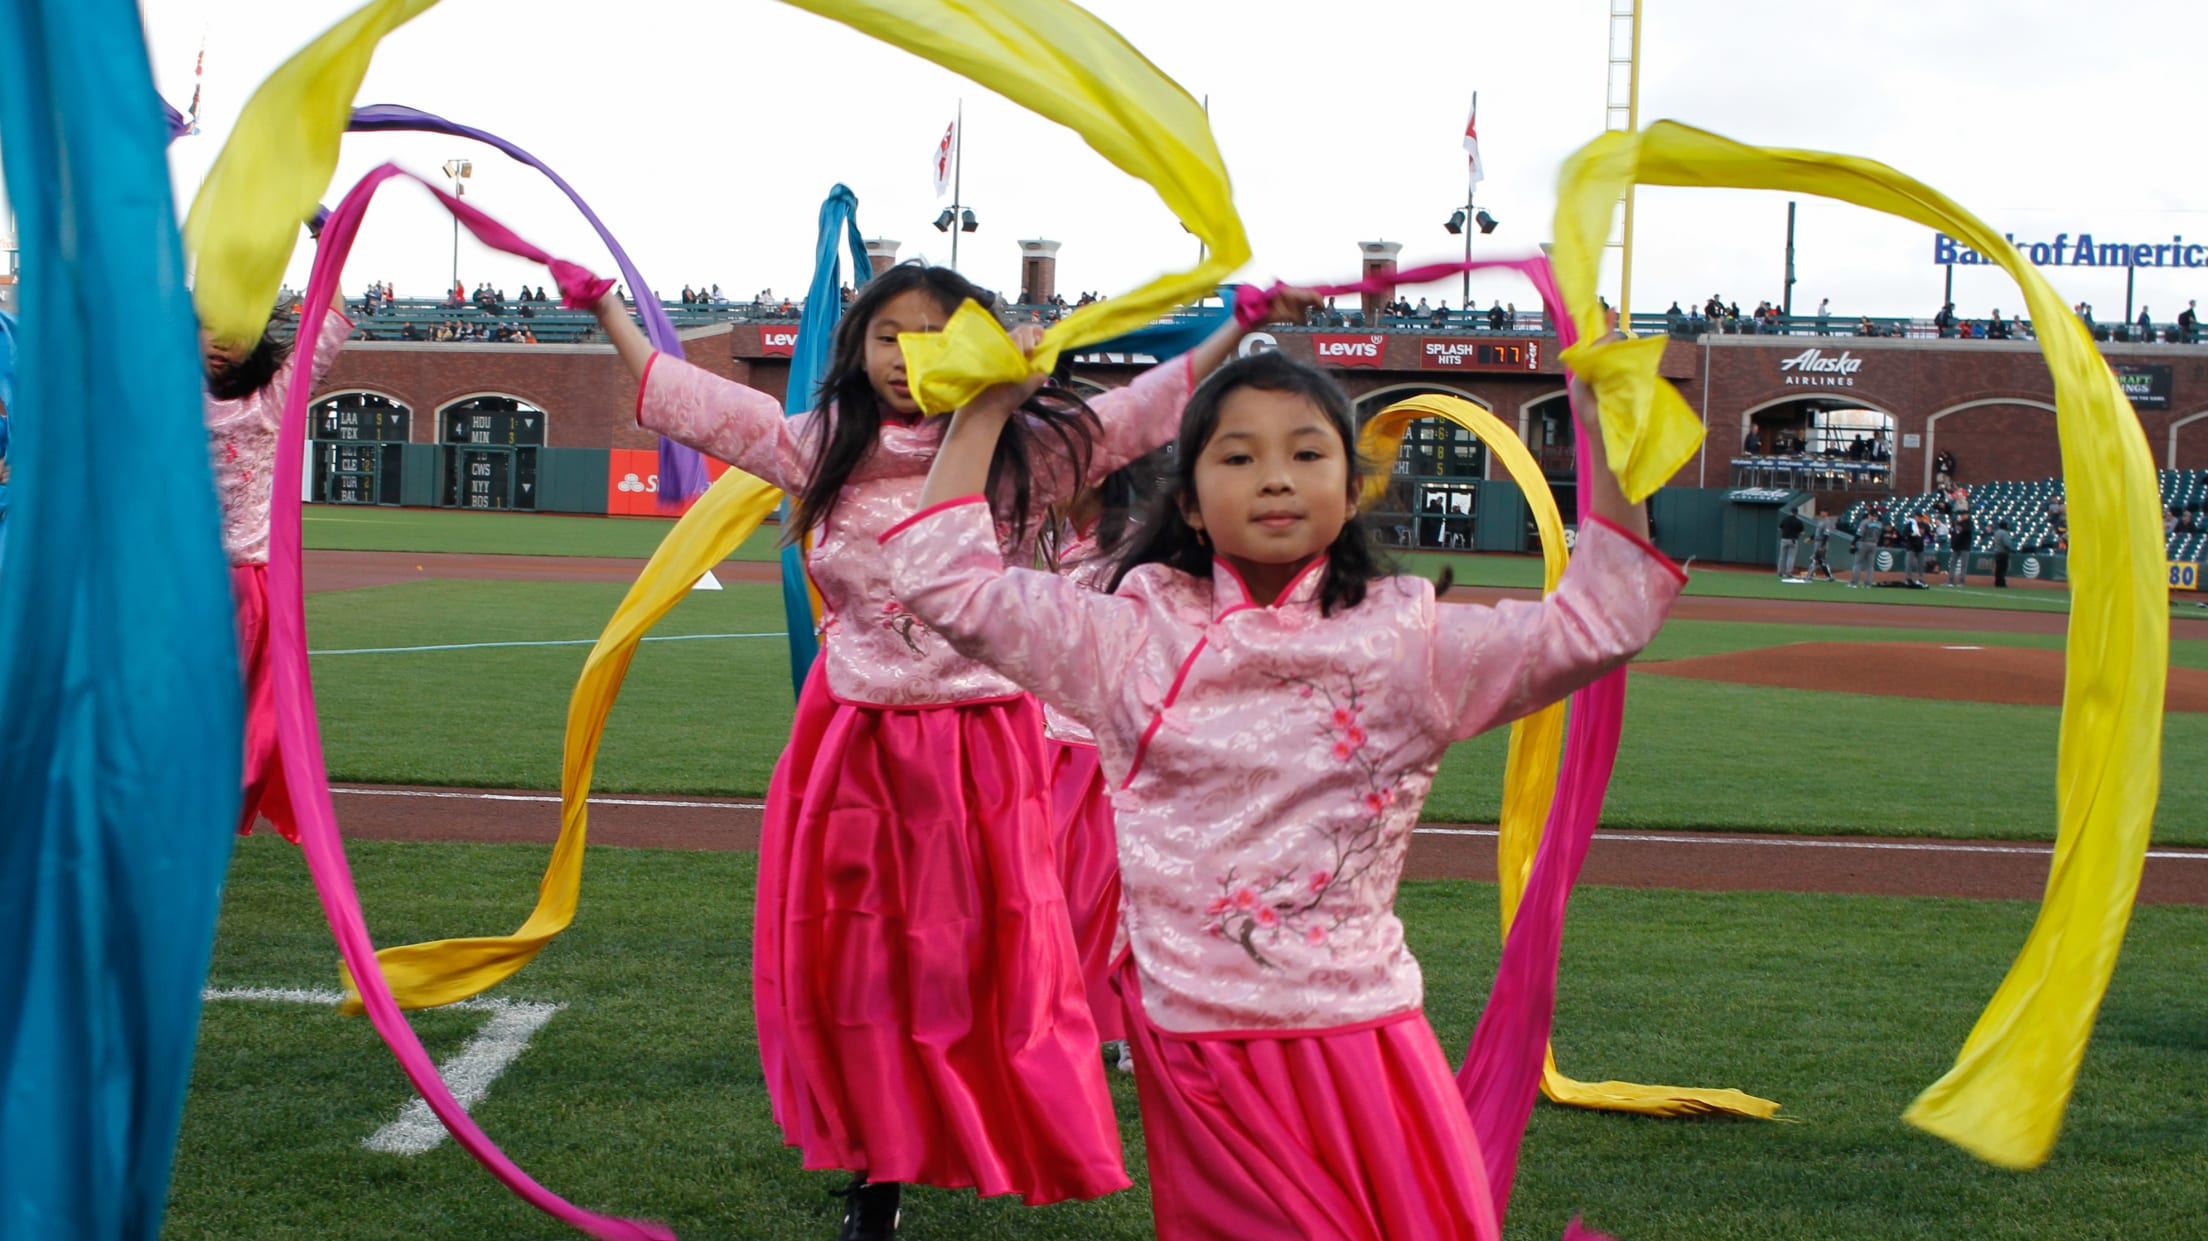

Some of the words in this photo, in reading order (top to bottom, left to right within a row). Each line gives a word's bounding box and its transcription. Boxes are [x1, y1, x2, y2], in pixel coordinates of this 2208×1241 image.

[2030, 233, 2067, 266] of
[2072, 234, 2208, 267] Americ
[765, 333, 799, 346] Lev
[1426, 343, 1473, 355] SPLASH
[1494, 346, 1520, 363] 77
[1438, 355, 1462, 365] HITS
[1781, 348, 1862, 375] Alaska
[1785, 376, 1854, 386] AIRLINES
[2117, 375, 2151, 384] RAFT
[2121, 384, 2150, 393] INGS
[340, 412, 358, 424] LAA
[472, 416, 491, 429] HOU
[340, 427, 358, 439] TEX
[455, 423, 462, 435] 4
[471, 431, 490, 443] MIN
[508, 432, 515, 444] 3
[1399, 445, 1413, 458] IT
[342, 459, 358, 471] CLE
[472, 463, 491, 476] CWS
[1437, 462, 1444, 476] 5
[472, 480, 490, 493] NYY
[341, 490, 357, 501] BAL
[472, 495, 489, 508] BOS
